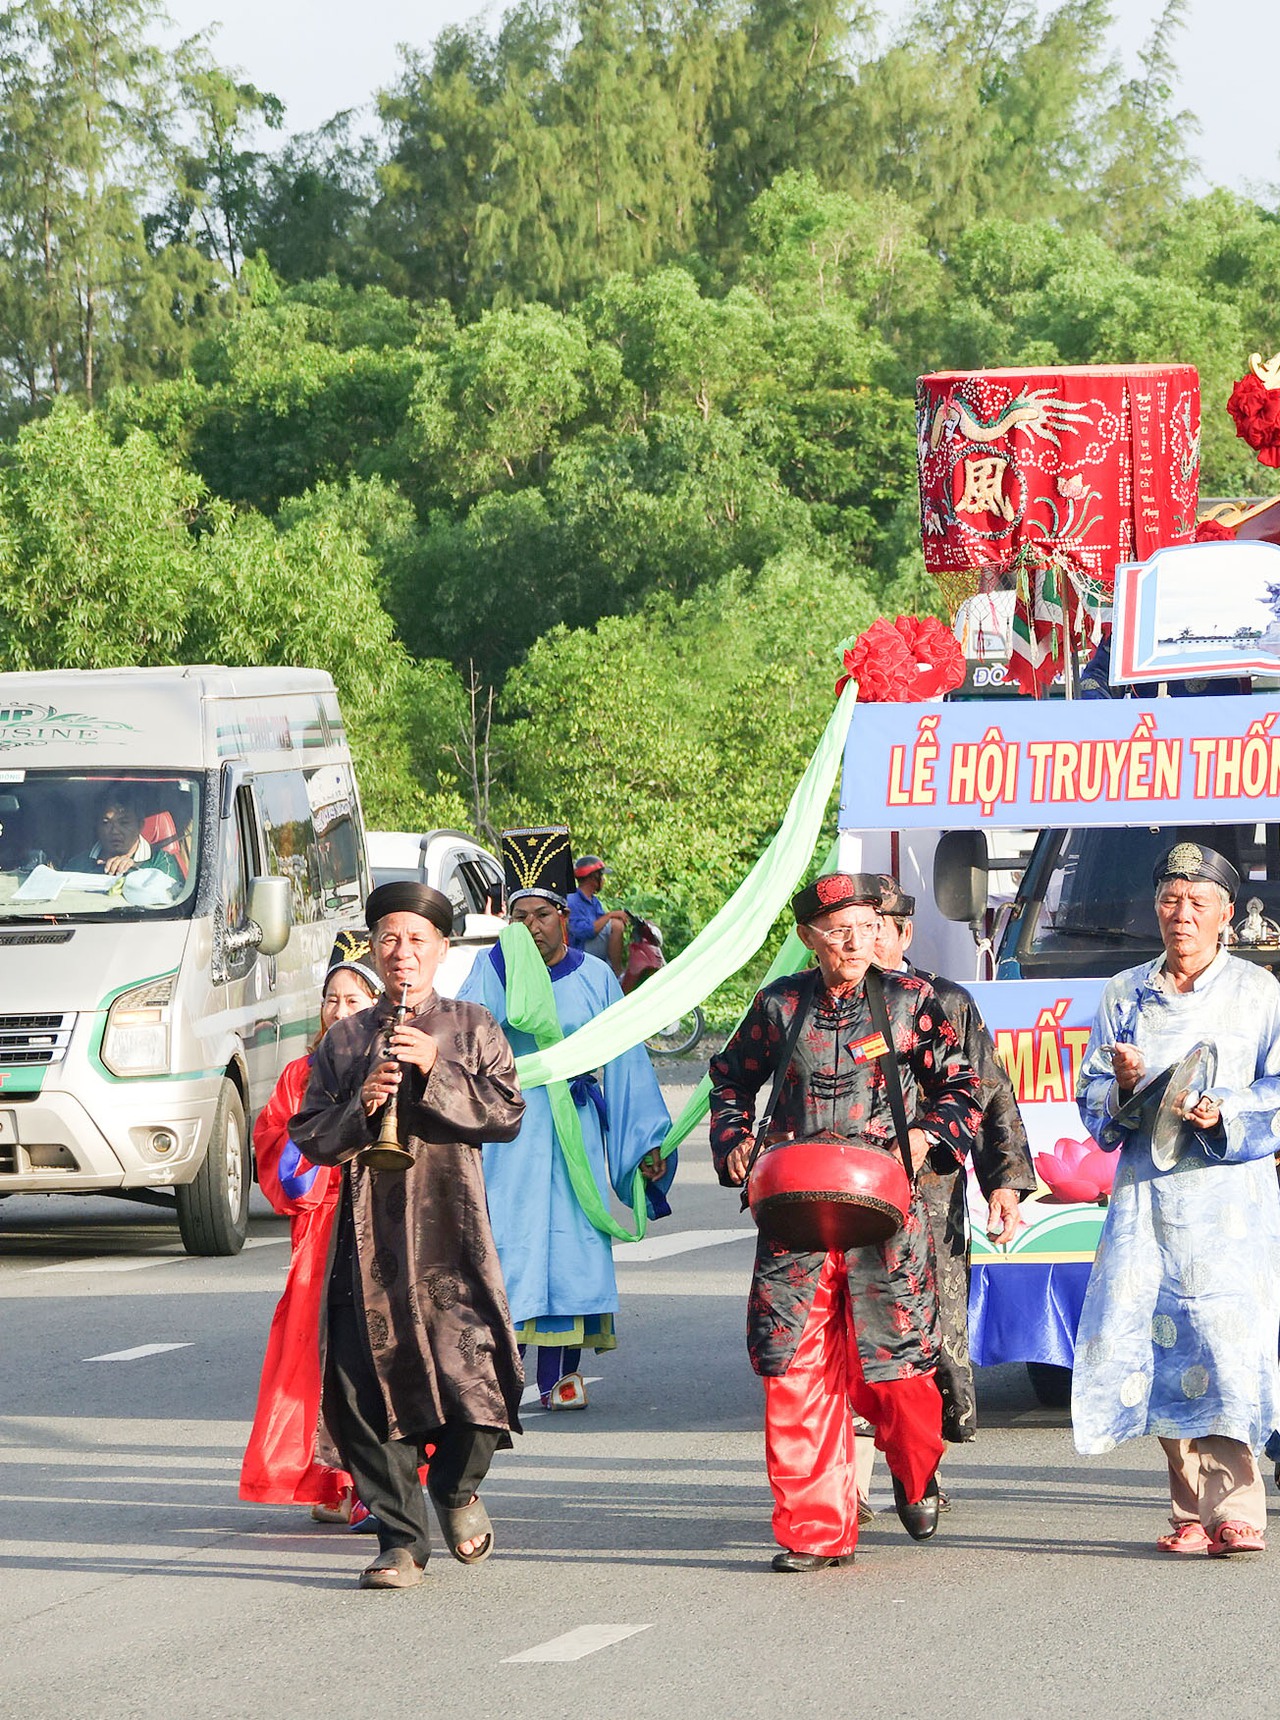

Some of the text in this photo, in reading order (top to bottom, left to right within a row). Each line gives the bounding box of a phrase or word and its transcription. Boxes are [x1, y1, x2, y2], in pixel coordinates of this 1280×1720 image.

[886, 714, 941, 806] LỄ
[948, 726, 1020, 817] HỘI
[1027, 713, 1183, 802] TRUYỀN
